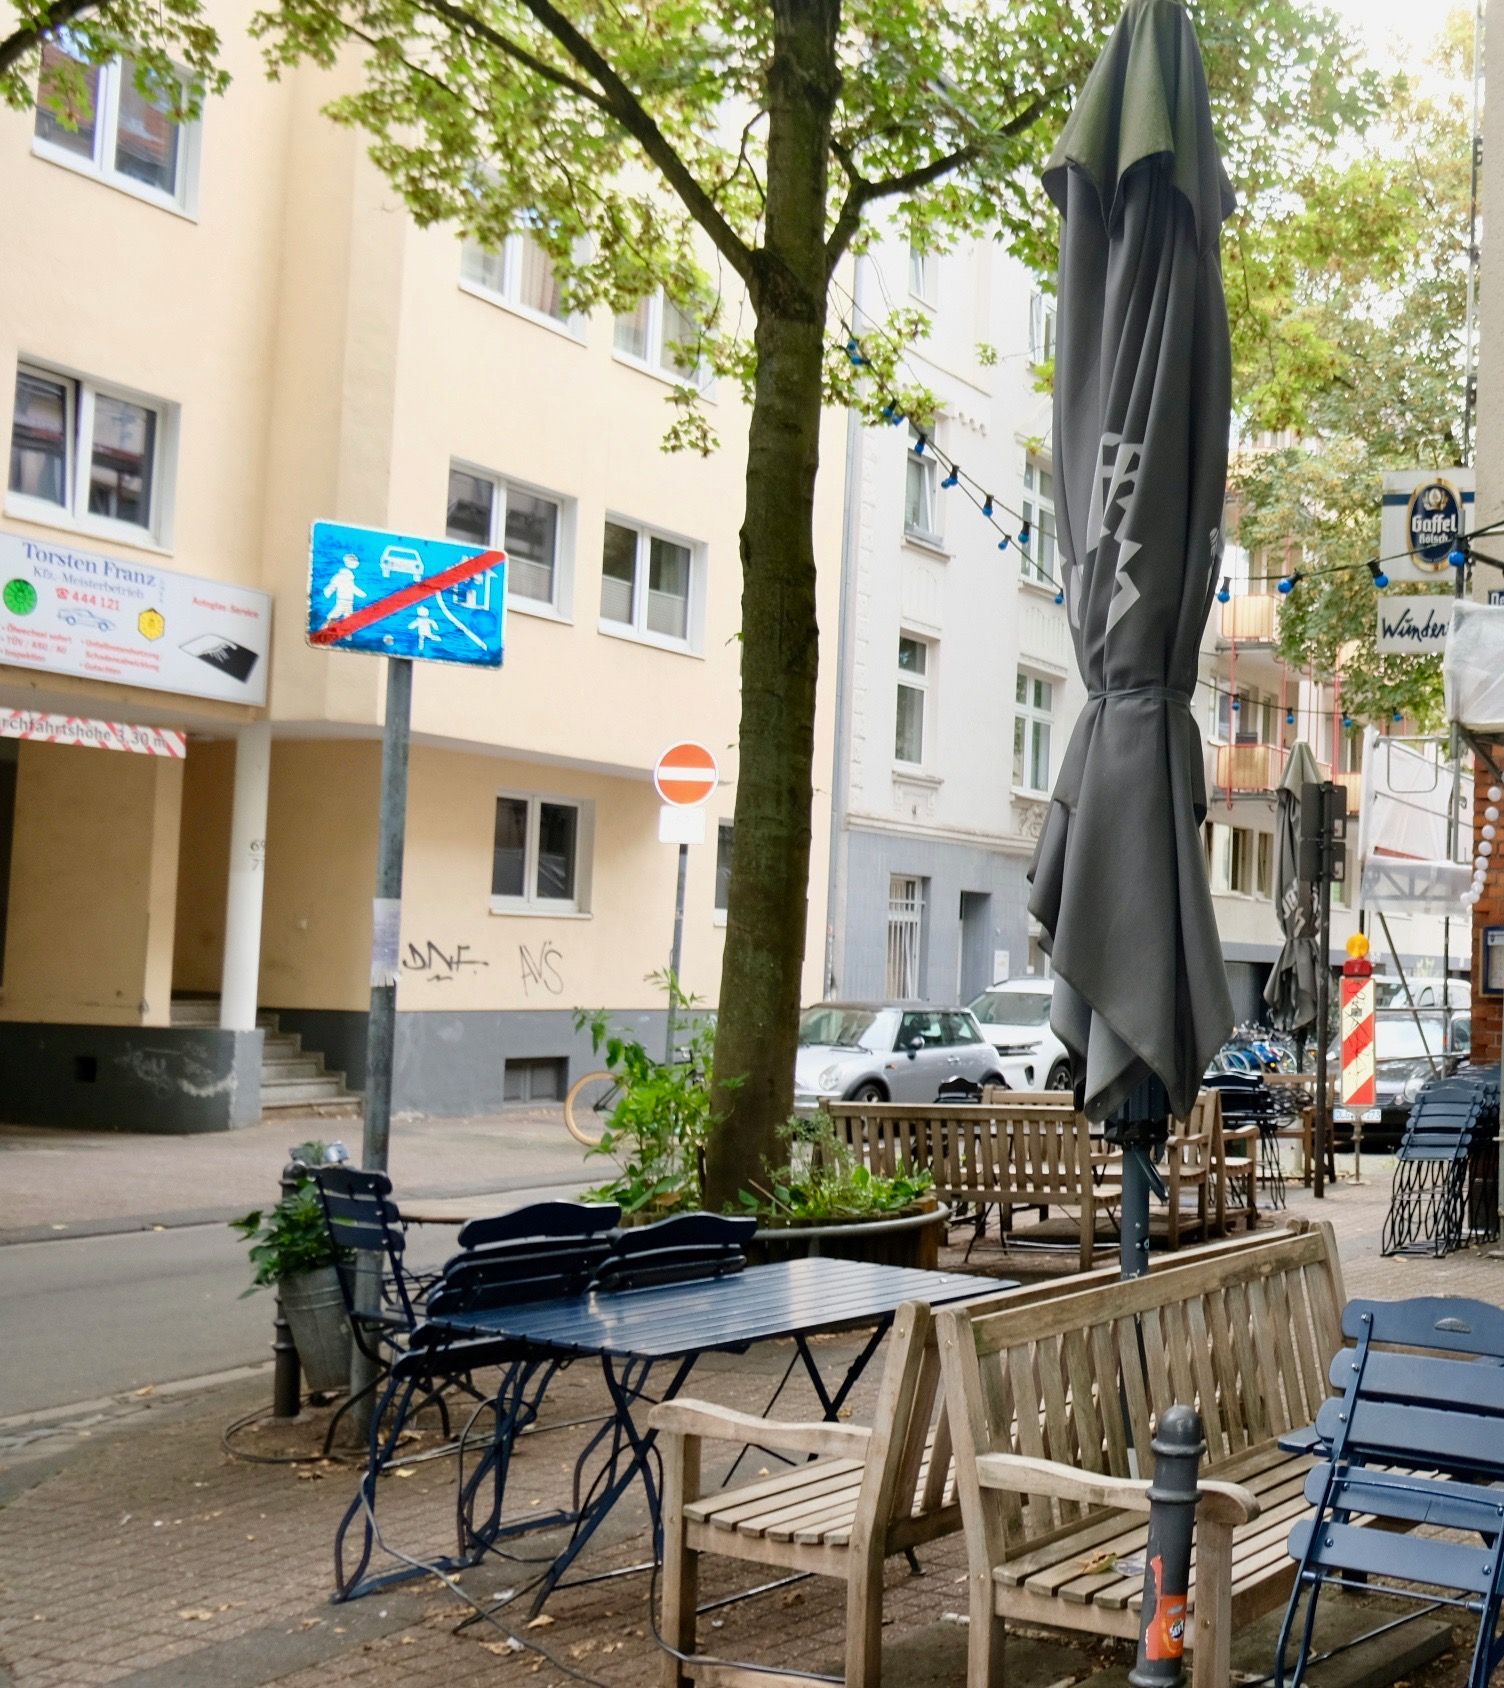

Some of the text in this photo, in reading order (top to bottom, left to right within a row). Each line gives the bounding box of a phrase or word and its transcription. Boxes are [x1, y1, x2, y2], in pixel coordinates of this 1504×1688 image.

[1411, 514, 1457, 533] Gaffel
[22, 541, 157, 587] Torsten Franz
[71, 591, 120, 611] 444 121
[1382, 608, 1450, 642] Wunder
